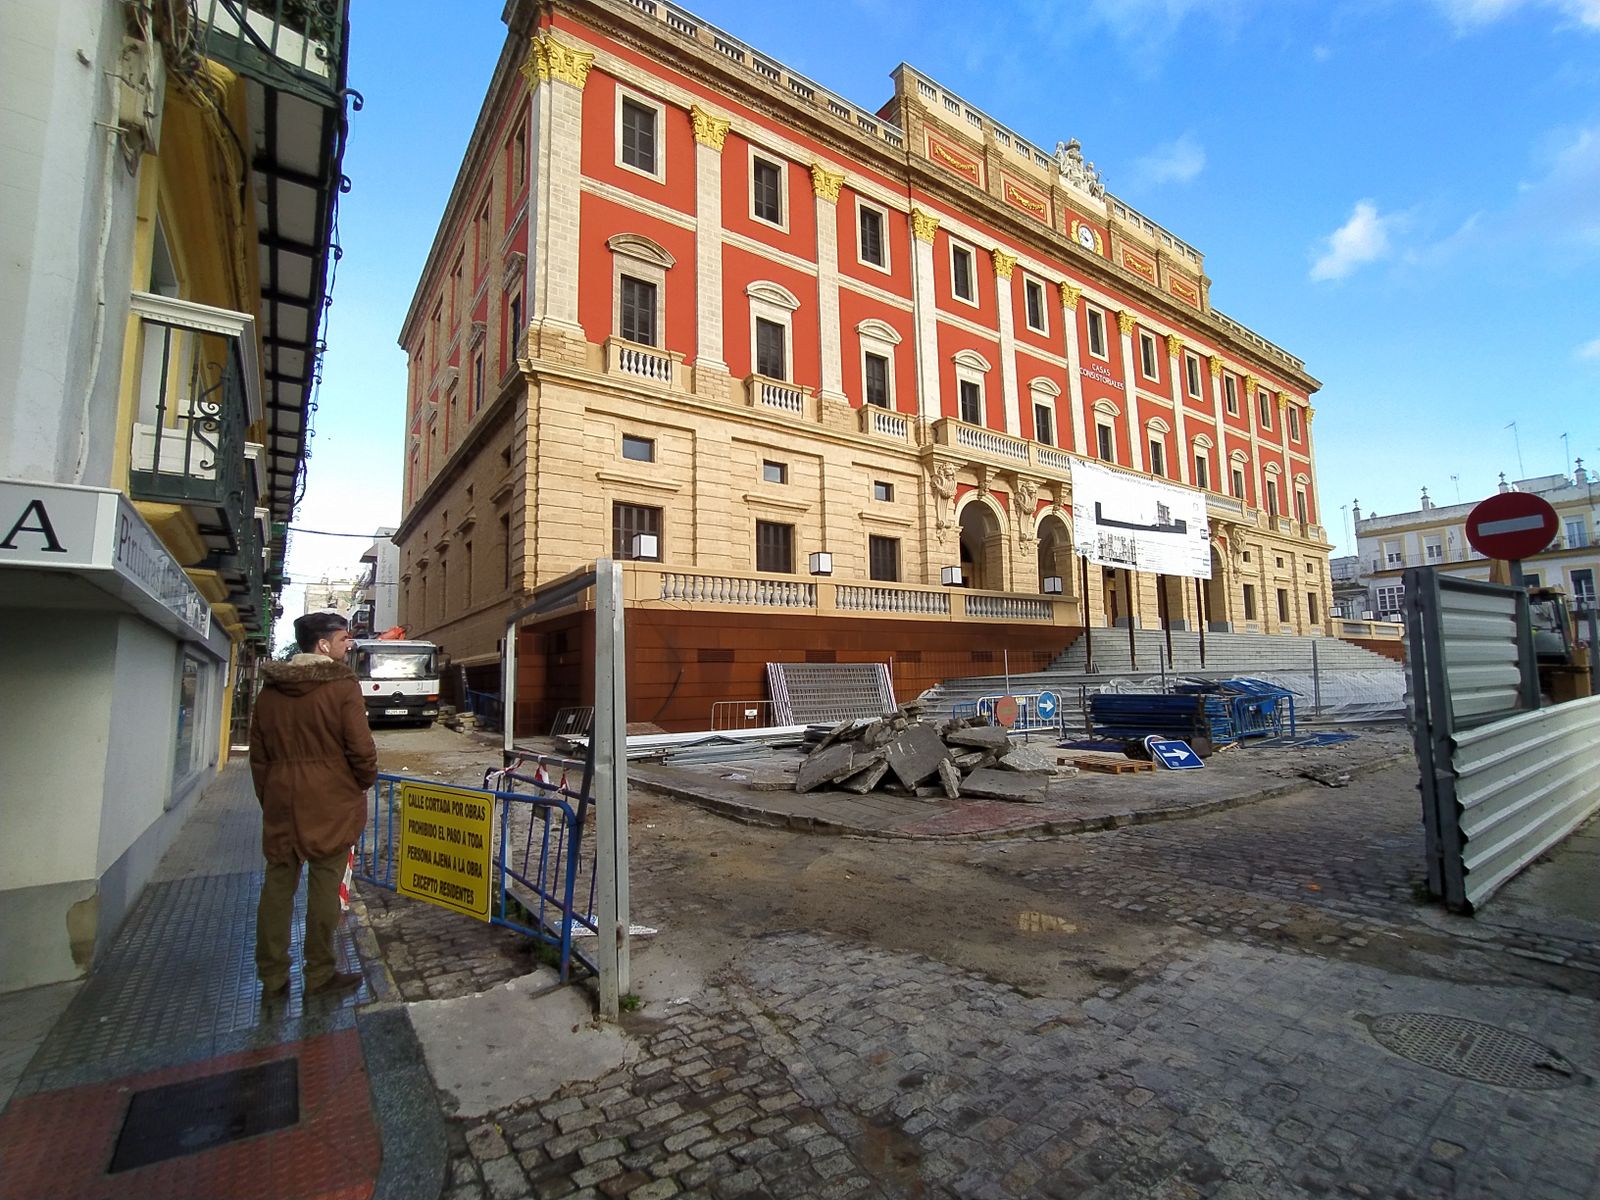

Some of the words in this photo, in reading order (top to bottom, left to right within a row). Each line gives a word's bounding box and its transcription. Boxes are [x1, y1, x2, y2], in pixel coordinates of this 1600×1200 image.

[1079, 367, 1125, 391] CONSISTORIALES
[1091, 363, 1111, 376] CASAS
[408, 793, 424, 809] CALLE
[425, 796, 451, 813] CORTADA
[452, 803, 464, 816] POR
[465, 803, 486, 821] OBRAS
[408, 819, 437, 839] PROHIBIDO
[438, 827, 446, 841] EL
[446, 827, 461, 844] PASO
[462, 831, 467, 846] A
[468, 832, 484, 850] TODA
[407, 845, 432, 865] PERSONA
[432, 851, 452, 870] AJENA
[452, 856, 457, 871] A
[458, 858, 466, 875] LA
[466, 860, 483, 879] OBRA
[412, 873, 438, 894] EXCEPTO
[439, 881, 475, 905] RESIDENTES
